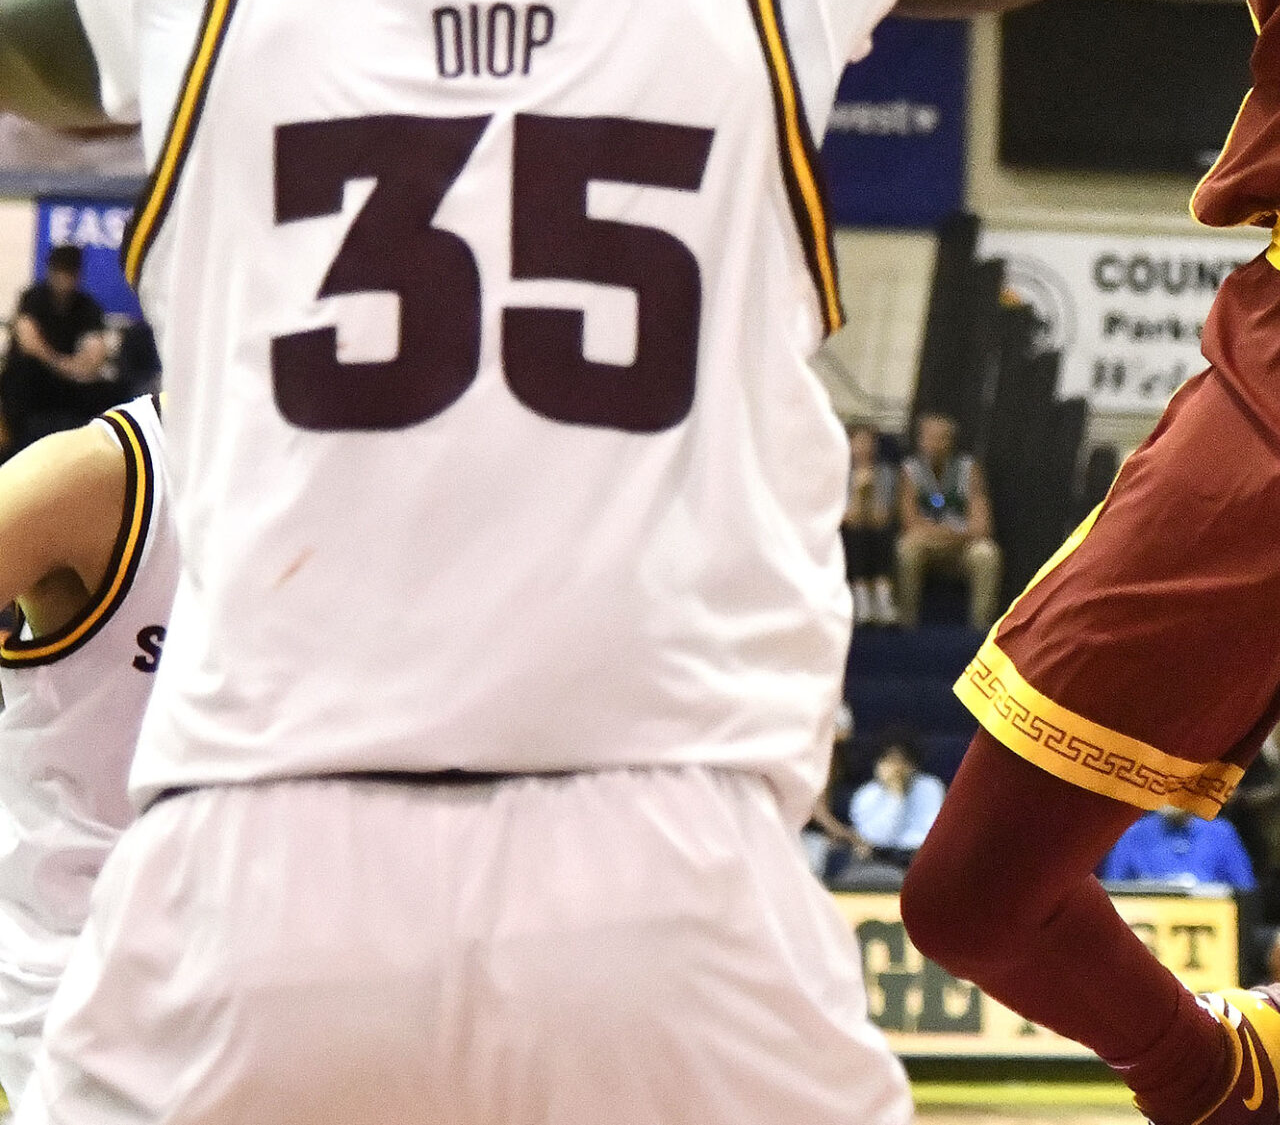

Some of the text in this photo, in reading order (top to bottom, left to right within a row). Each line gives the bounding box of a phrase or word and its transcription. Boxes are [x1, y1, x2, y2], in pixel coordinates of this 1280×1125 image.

[432, 2, 556, 78] DIOP
[49, 205, 131, 250] EAS
[271, 112, 715, 434] 35
[1093, 253, 1243, 294] COUN
[132, 625, 168, 674] S
